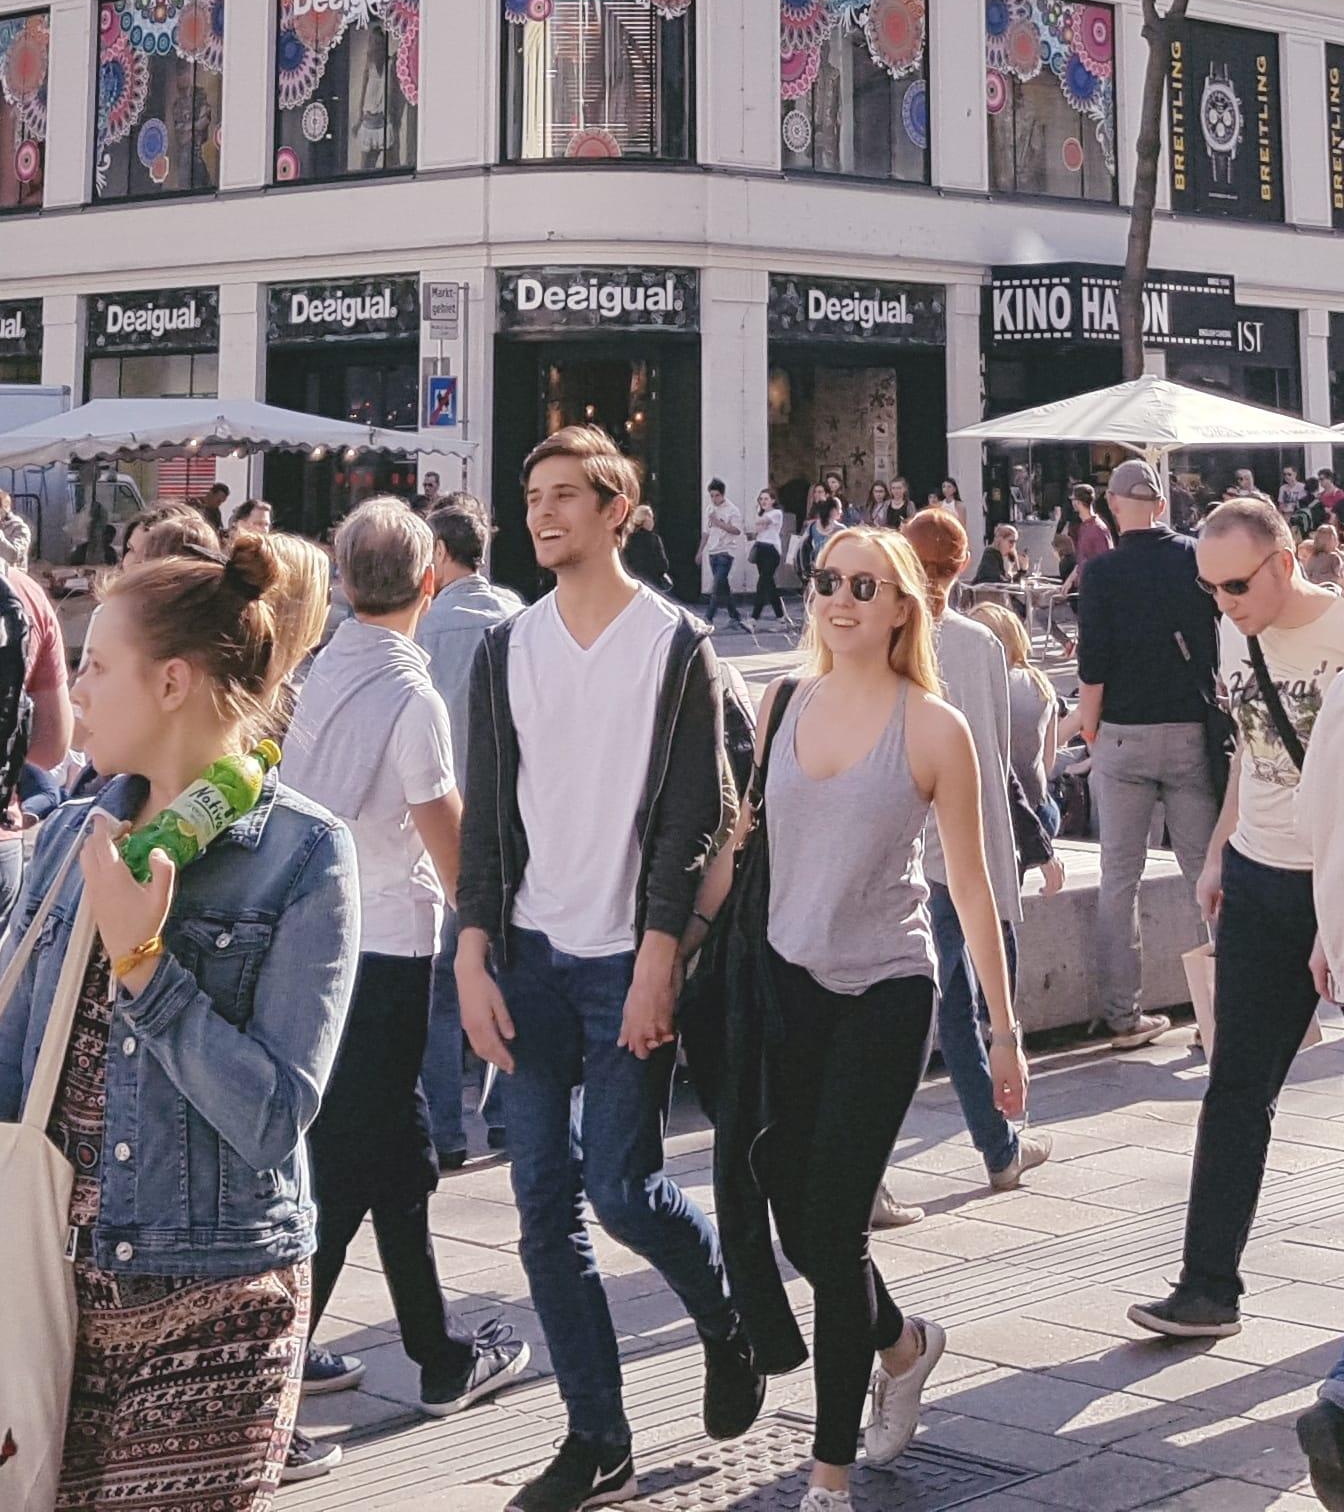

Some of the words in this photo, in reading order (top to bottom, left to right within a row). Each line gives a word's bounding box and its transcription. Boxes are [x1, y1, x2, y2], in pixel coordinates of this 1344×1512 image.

[1171, 40, 1186, 190] BREITLING
[1257, 55, 1272, 201] BREITLING
[1329, 67, 1344, 209] BREITLING
[992, 285, 1072, 332] KINO
[1081, 286, 1169, 334] HAN
